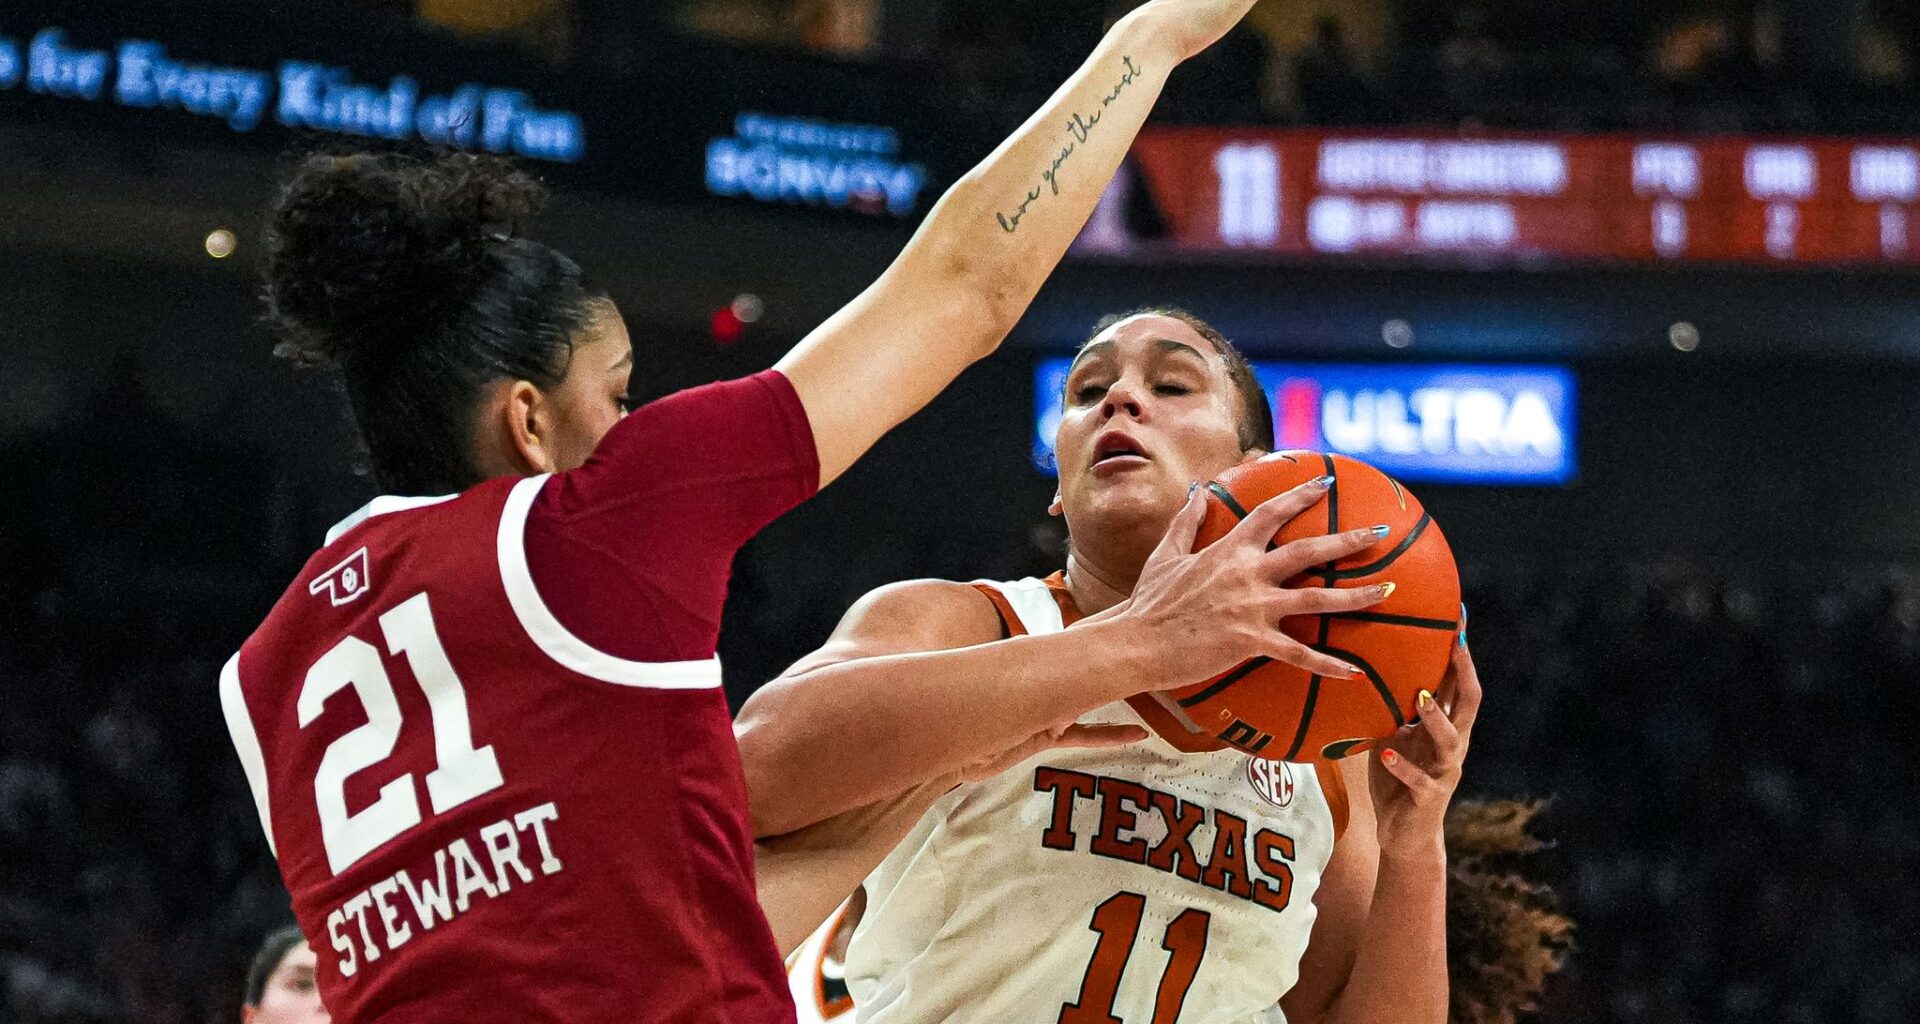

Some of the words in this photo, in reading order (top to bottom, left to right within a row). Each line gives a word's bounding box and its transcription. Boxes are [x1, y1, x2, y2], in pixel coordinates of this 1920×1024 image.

[280, 61, 415, 138] Kind
[997, 186, 1040, 233] love
[1043, 143, 1074, 196] you
[1067, 112, 1101, 144] the
[1322, 389, 1562, 456] ULTRA
[297, 591, 504, 877] 21
[1251, 757, 1293, 807] SEC
[327, 802, 562, 978] STEWART
[1034, 766, 1295, 912] TEXAS
[1057, 891, 1211, 1024] 11
